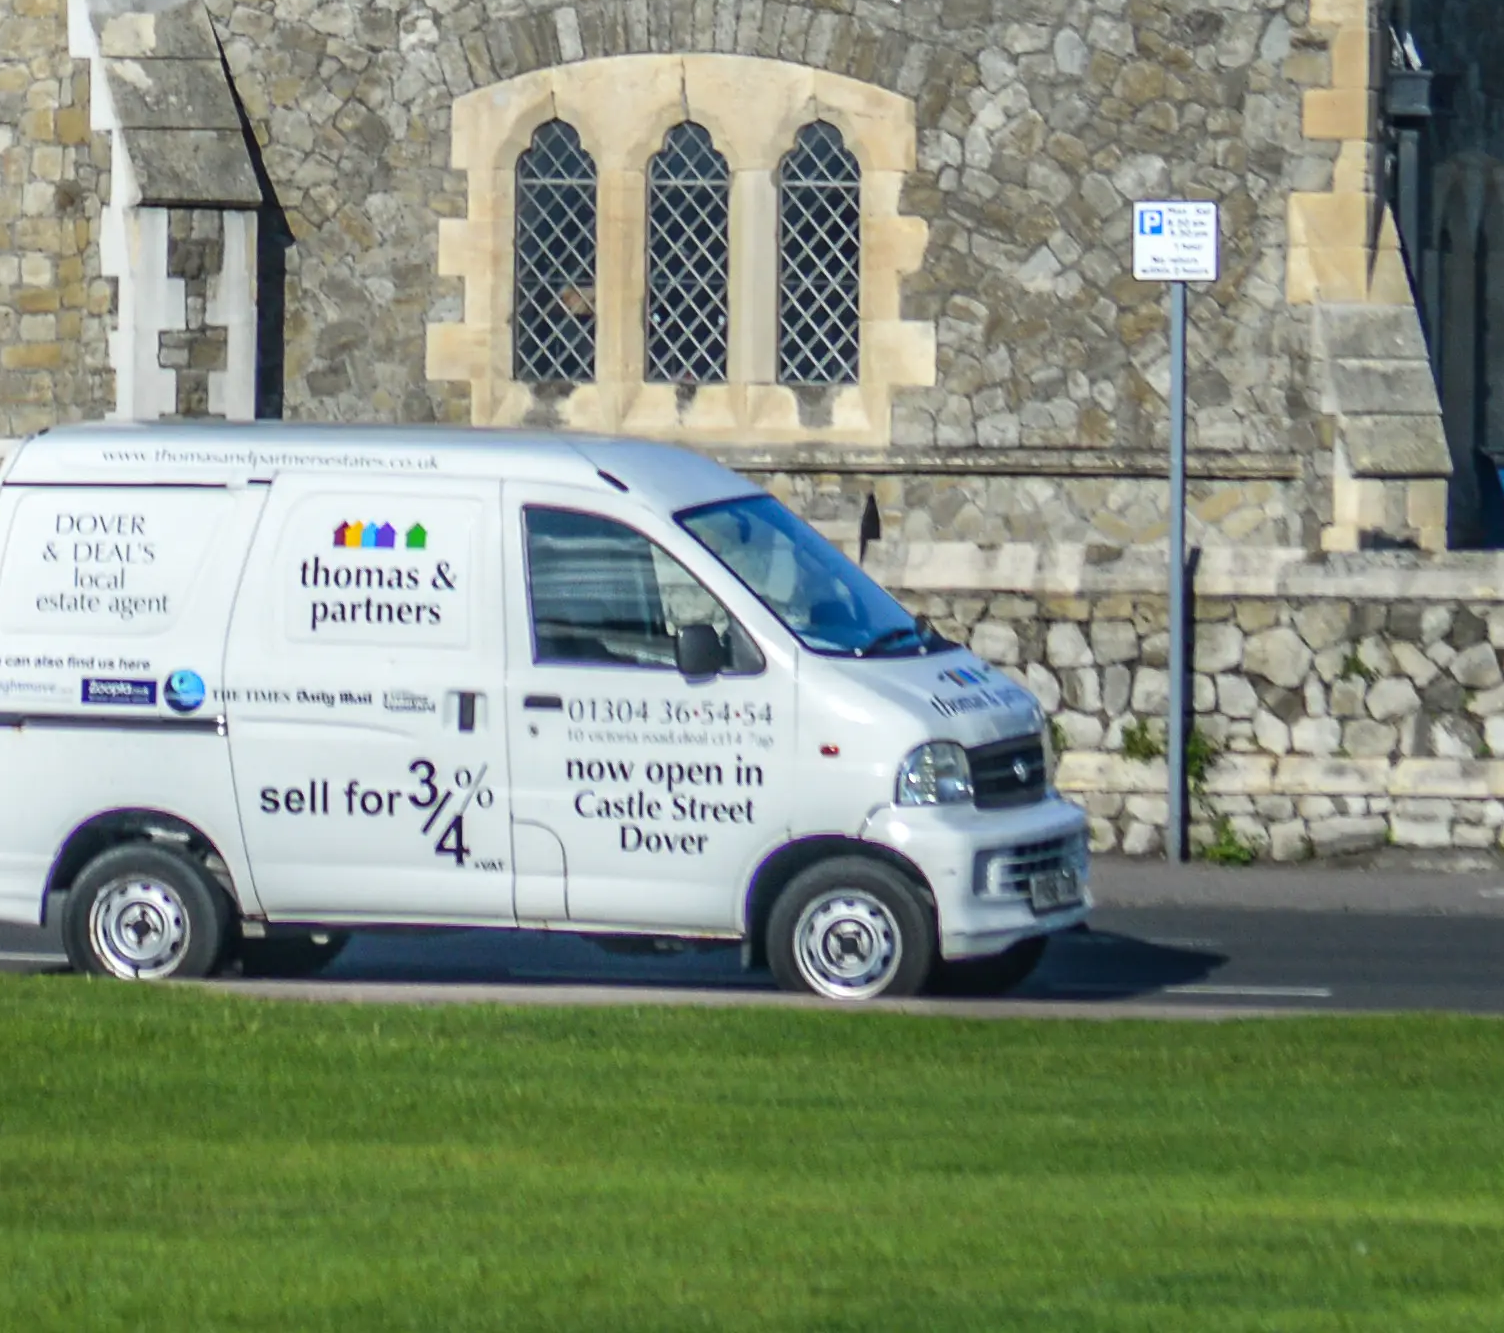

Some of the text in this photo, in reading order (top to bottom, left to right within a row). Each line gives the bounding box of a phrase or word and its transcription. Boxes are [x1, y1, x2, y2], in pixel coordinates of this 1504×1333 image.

[56, 513, 146, 535] DOVER
[42, 541, 156, 564] & DEAL'S
[74, 566, 125, 590] local
[300, 556, 457, 591] thomas &
[36, 592, 169, 621] estate agent
[310, 597, 442, 632] partners
[5, 655, 31, 667] can
[34, 655, 64, 669] also
[67, 656, 95, 670] find
[98, 659, 115, 670] us
[119, 658, 151, 671] here
[212, 689, 291, 703] THE TIMES
[296, 689, 373, 707] Daily Mail
[568, 699, 650, 724] 01304
[567, 754, 764, 792] now open in
[260, 780, 329, 815] sell
[344, 779, 402, 815] for
[574, 789, 755, 824] Castle Street
[620, 825, 709, 854] Dover
